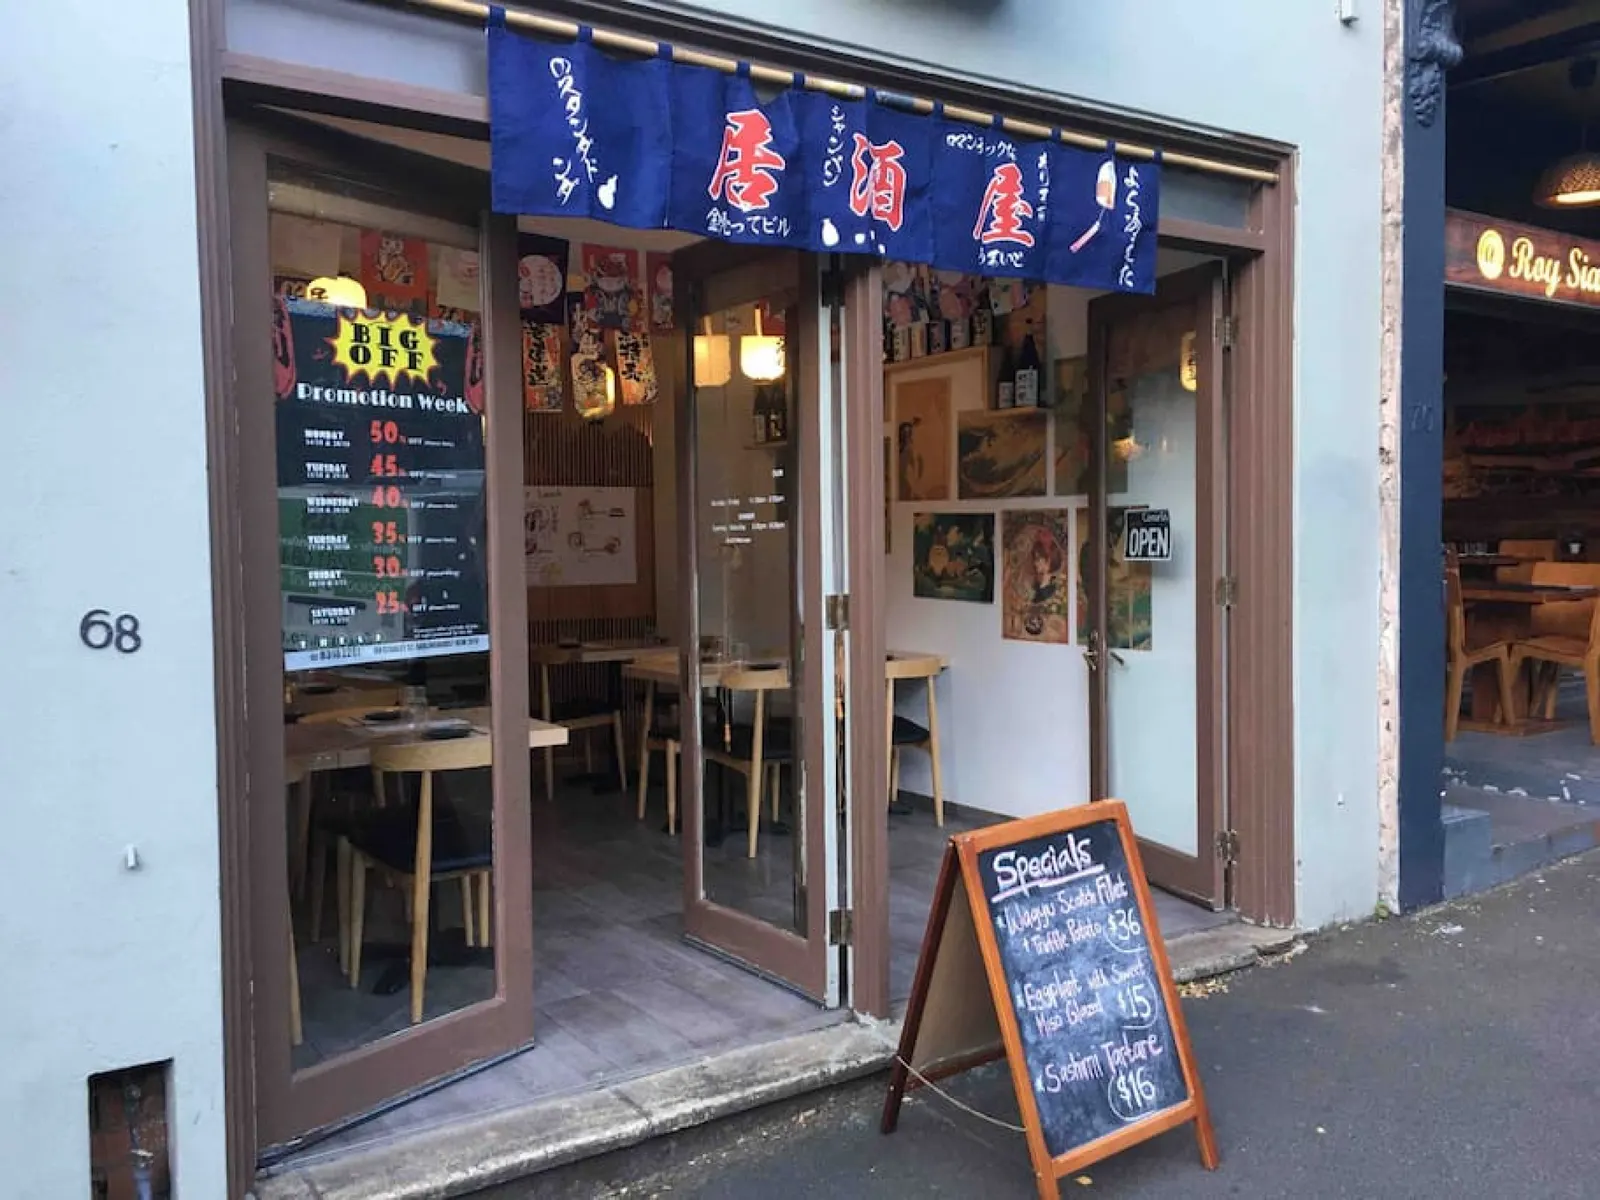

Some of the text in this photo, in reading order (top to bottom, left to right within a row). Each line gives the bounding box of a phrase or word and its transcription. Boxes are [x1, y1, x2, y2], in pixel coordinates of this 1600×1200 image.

[1508, 236, 1562, 298] Roy
[351, 322, 421, 351] BIG
[349, 345, 424, 372] OFF
[296, 382, 470, 414] Promotion Week
[1128, 527, 1169, 556] OPEN
[80, 609, 142, 653] 68
[993, 832, 1092, 896] Specials
[1003, 903, 1056, 936] Wagyu
[1107, 908, 1141, 941] $36
[1024, 969, 1082, 1011] Eggplant
[1118, 983, 1153, 1019] $15
[1045, 1031, 1163, 1093] Sashimi Tartare
[1116, 1067, 1157, 1110] $16
